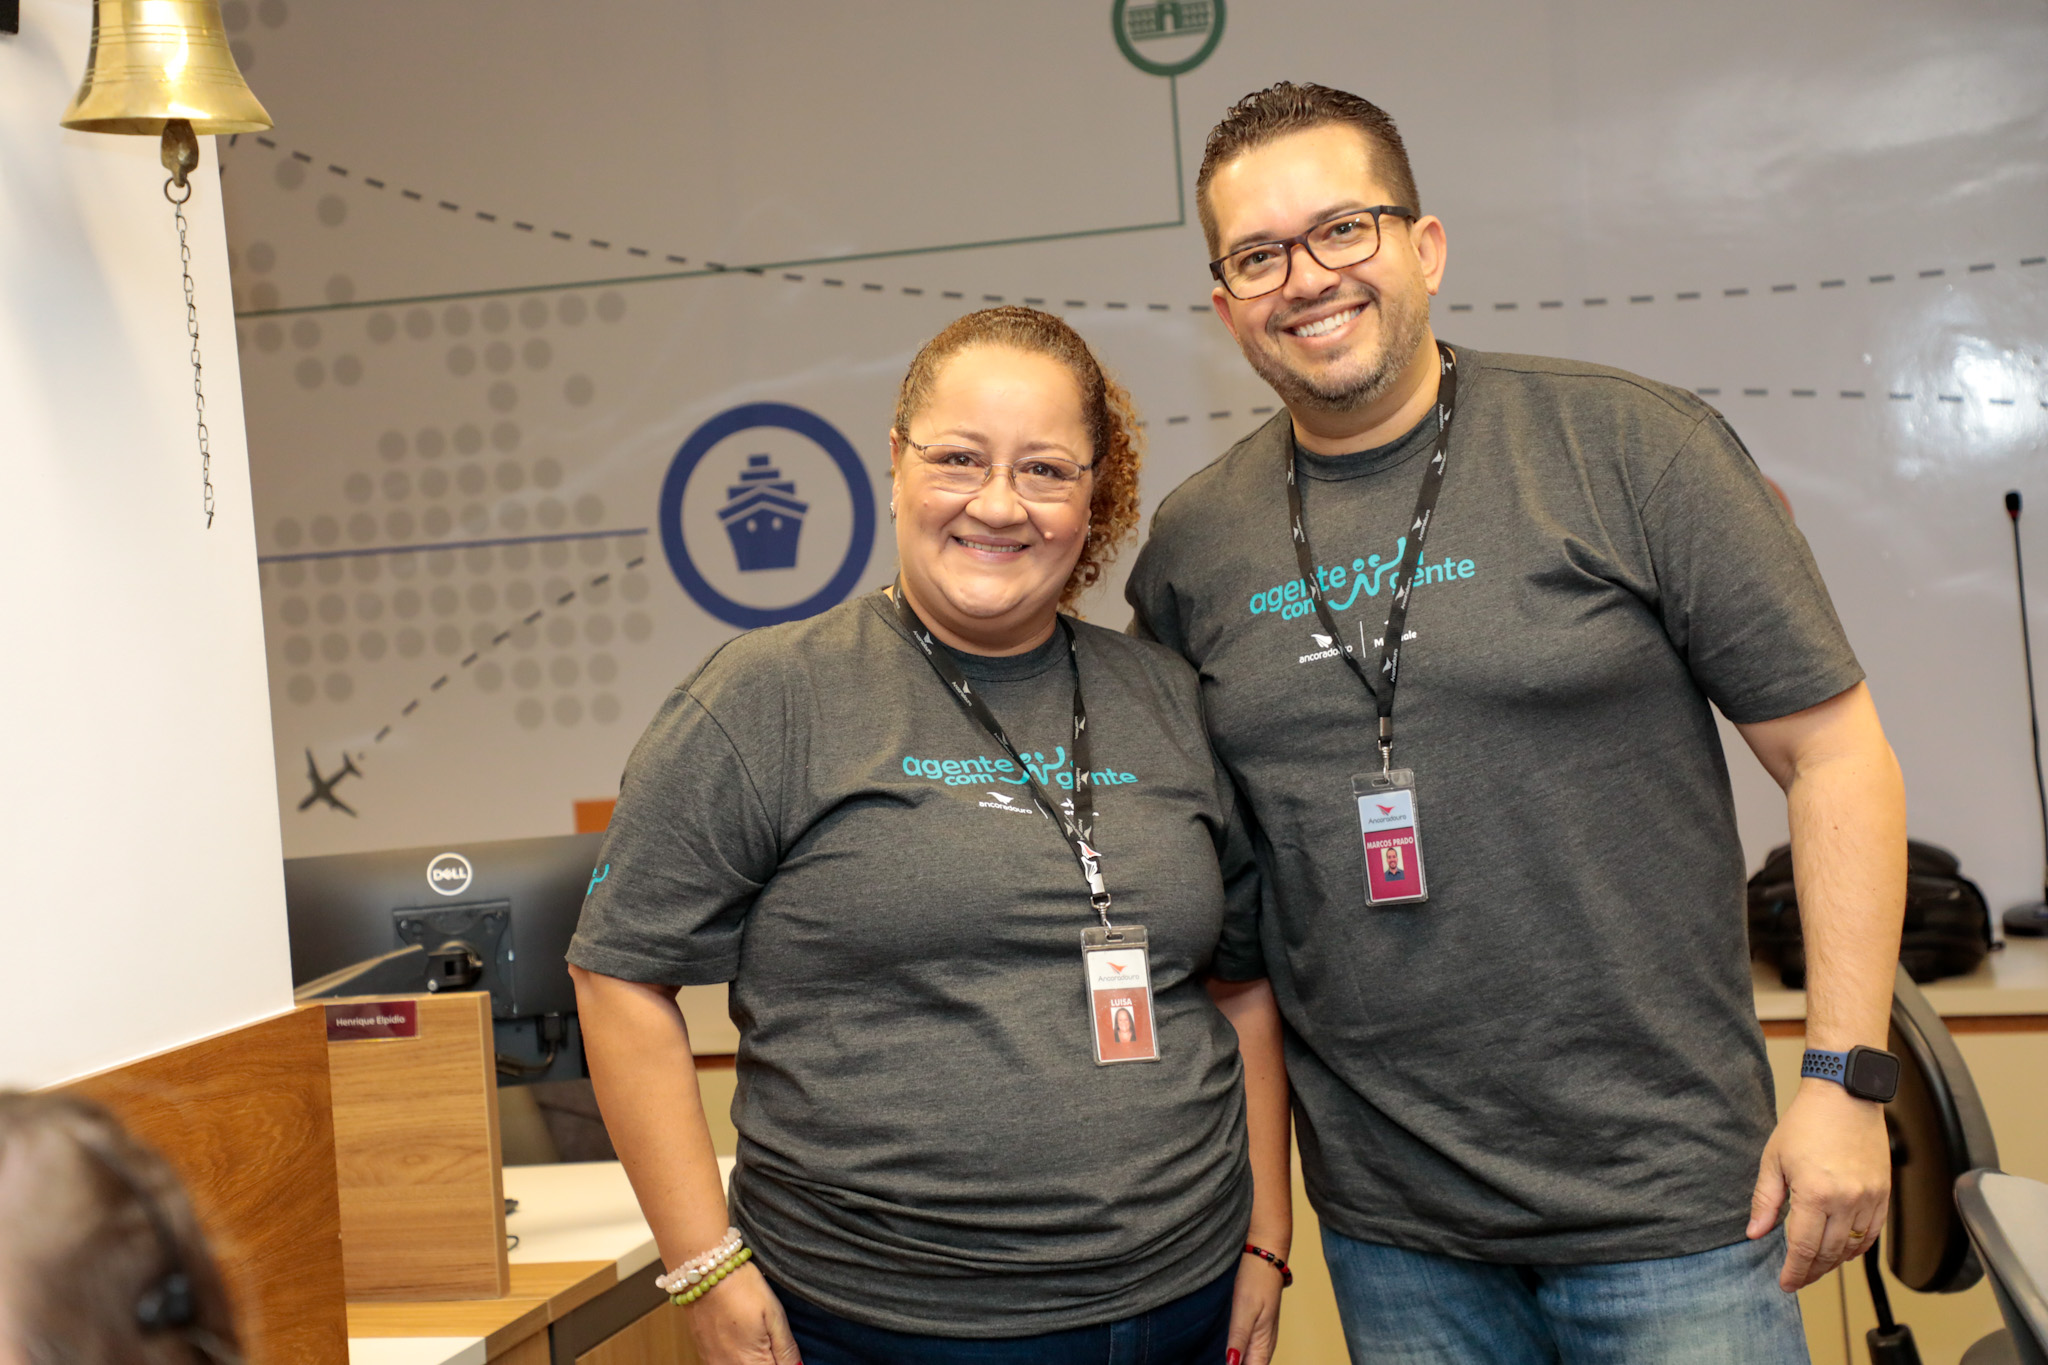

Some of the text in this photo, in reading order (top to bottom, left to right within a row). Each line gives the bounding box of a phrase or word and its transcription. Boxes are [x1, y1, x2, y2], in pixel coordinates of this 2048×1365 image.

[902, 755, 1015, 780] agente
[944, 771, 995, 786] com
[1055, 767, 1139, 790] gnte
[1368, 814, 1407, 825] Ancoradouro
[1366, 836, 1414, 849] MARCOS PRADO
[433, 867, 467, 881] DELL
[1098, 974, 1140, 982] Ancoradouro
[1110, 998, 1133, 1007] LUISA
[335, 1014, 406, 1027] Henrique Elpidio
